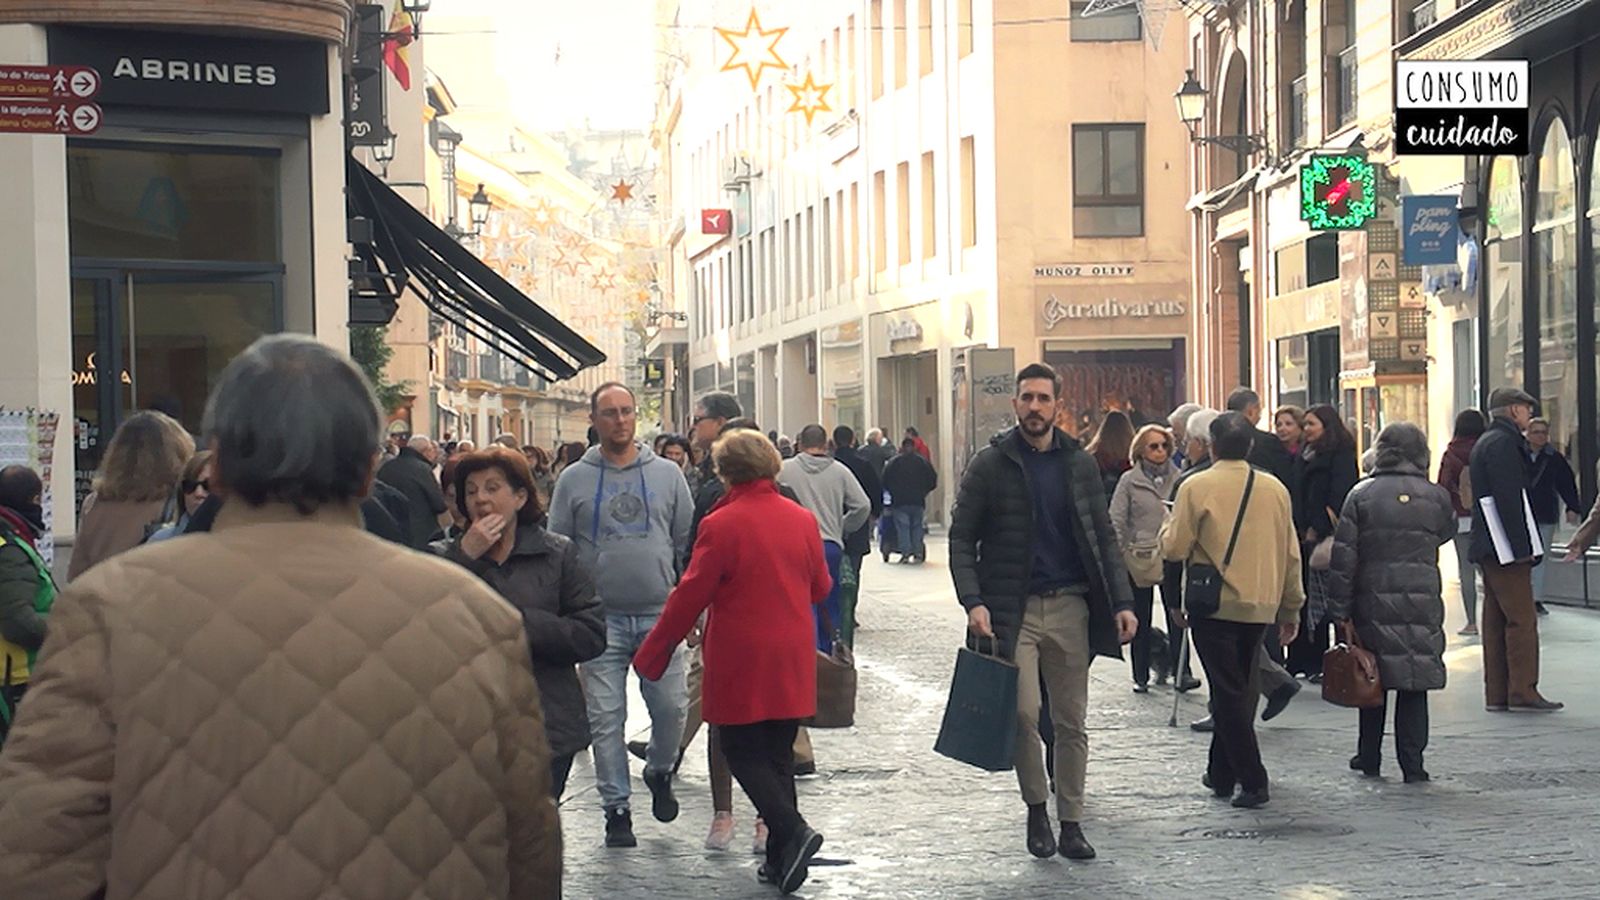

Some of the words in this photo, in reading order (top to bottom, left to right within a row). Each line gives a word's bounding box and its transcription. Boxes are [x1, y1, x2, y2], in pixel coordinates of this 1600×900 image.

[23, 71, 51, 81] Triana
[113, 57, 276, 86] ABRINES
[1415, 207, 1452, 222] pam
[1409, 217, 1452, 238] pling
